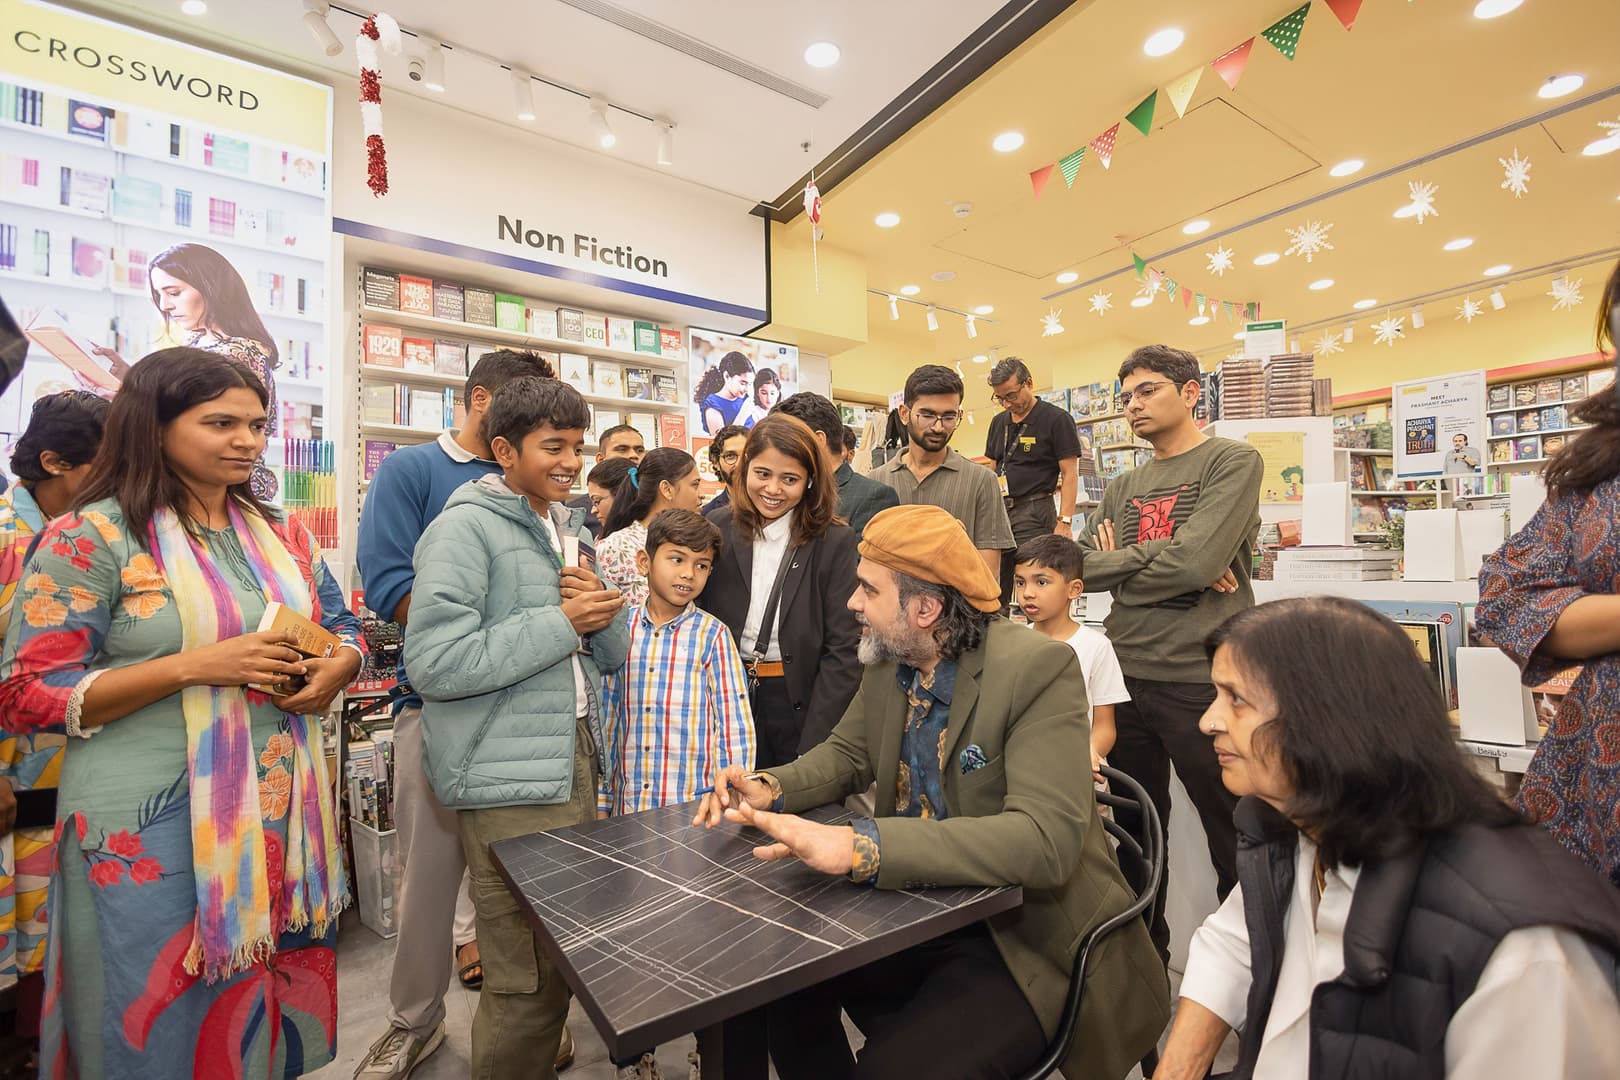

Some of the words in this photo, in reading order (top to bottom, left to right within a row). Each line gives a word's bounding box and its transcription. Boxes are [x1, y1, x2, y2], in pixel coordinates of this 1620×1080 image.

[14, 30, 260, 111] CROSSWORD
[498, 214, 565, 254] Non
[574, 233, 668, 278] Fiction
[368, 334, 400, 357] 1929
[585, 327, 604, 340] CEO
[1407, 441, 1433, 450] TRUTH
[1139, 498, 1173, 536] BE
